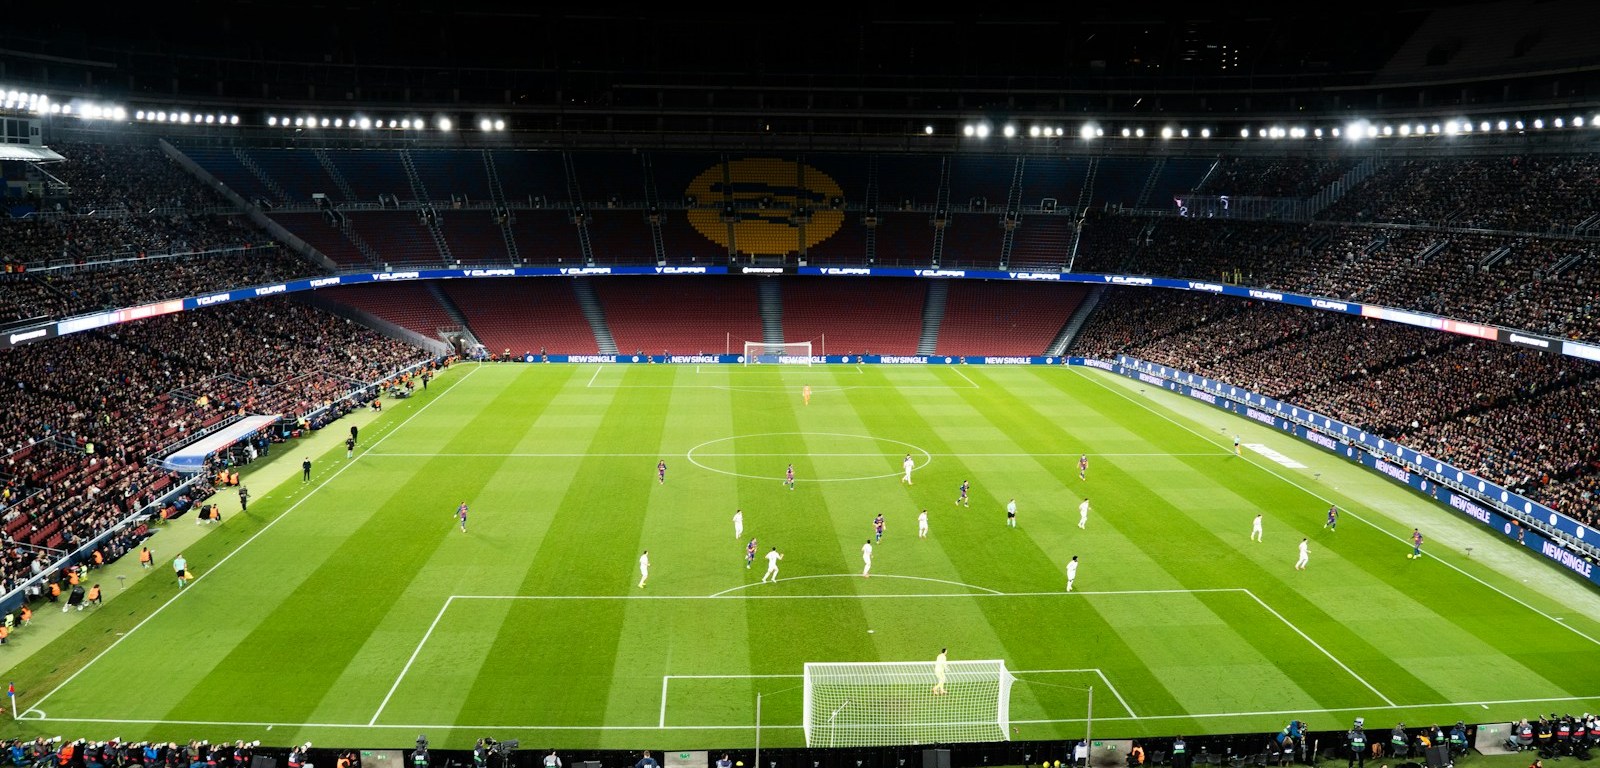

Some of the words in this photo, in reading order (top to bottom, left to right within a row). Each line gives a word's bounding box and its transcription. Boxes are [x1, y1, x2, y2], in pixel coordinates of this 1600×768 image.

[568, 355, 588, 363] NEW
[588, 355, 617, 363] SINGLE
[671, 355, 692, 363] NEW
[691, 355, 720, 363] SINGLE
[880, 356, 901, 364] NEW
[900, 356, 928, 364] SINGLE
[1306, 430, 1319, 443] NEW
[1318, 435, 1337, 451] SINGLE
[1375, 458, 1389, 474] NEW
[1388, 465, 1411, 484] SINGLE
[1450, 494, 1467, 511] NEW
[1465, 502, 1491, 524] SINGLE
[1542, 541, 1564, 561] NEW
[1561, 551, 1592, 578] SINGLE
